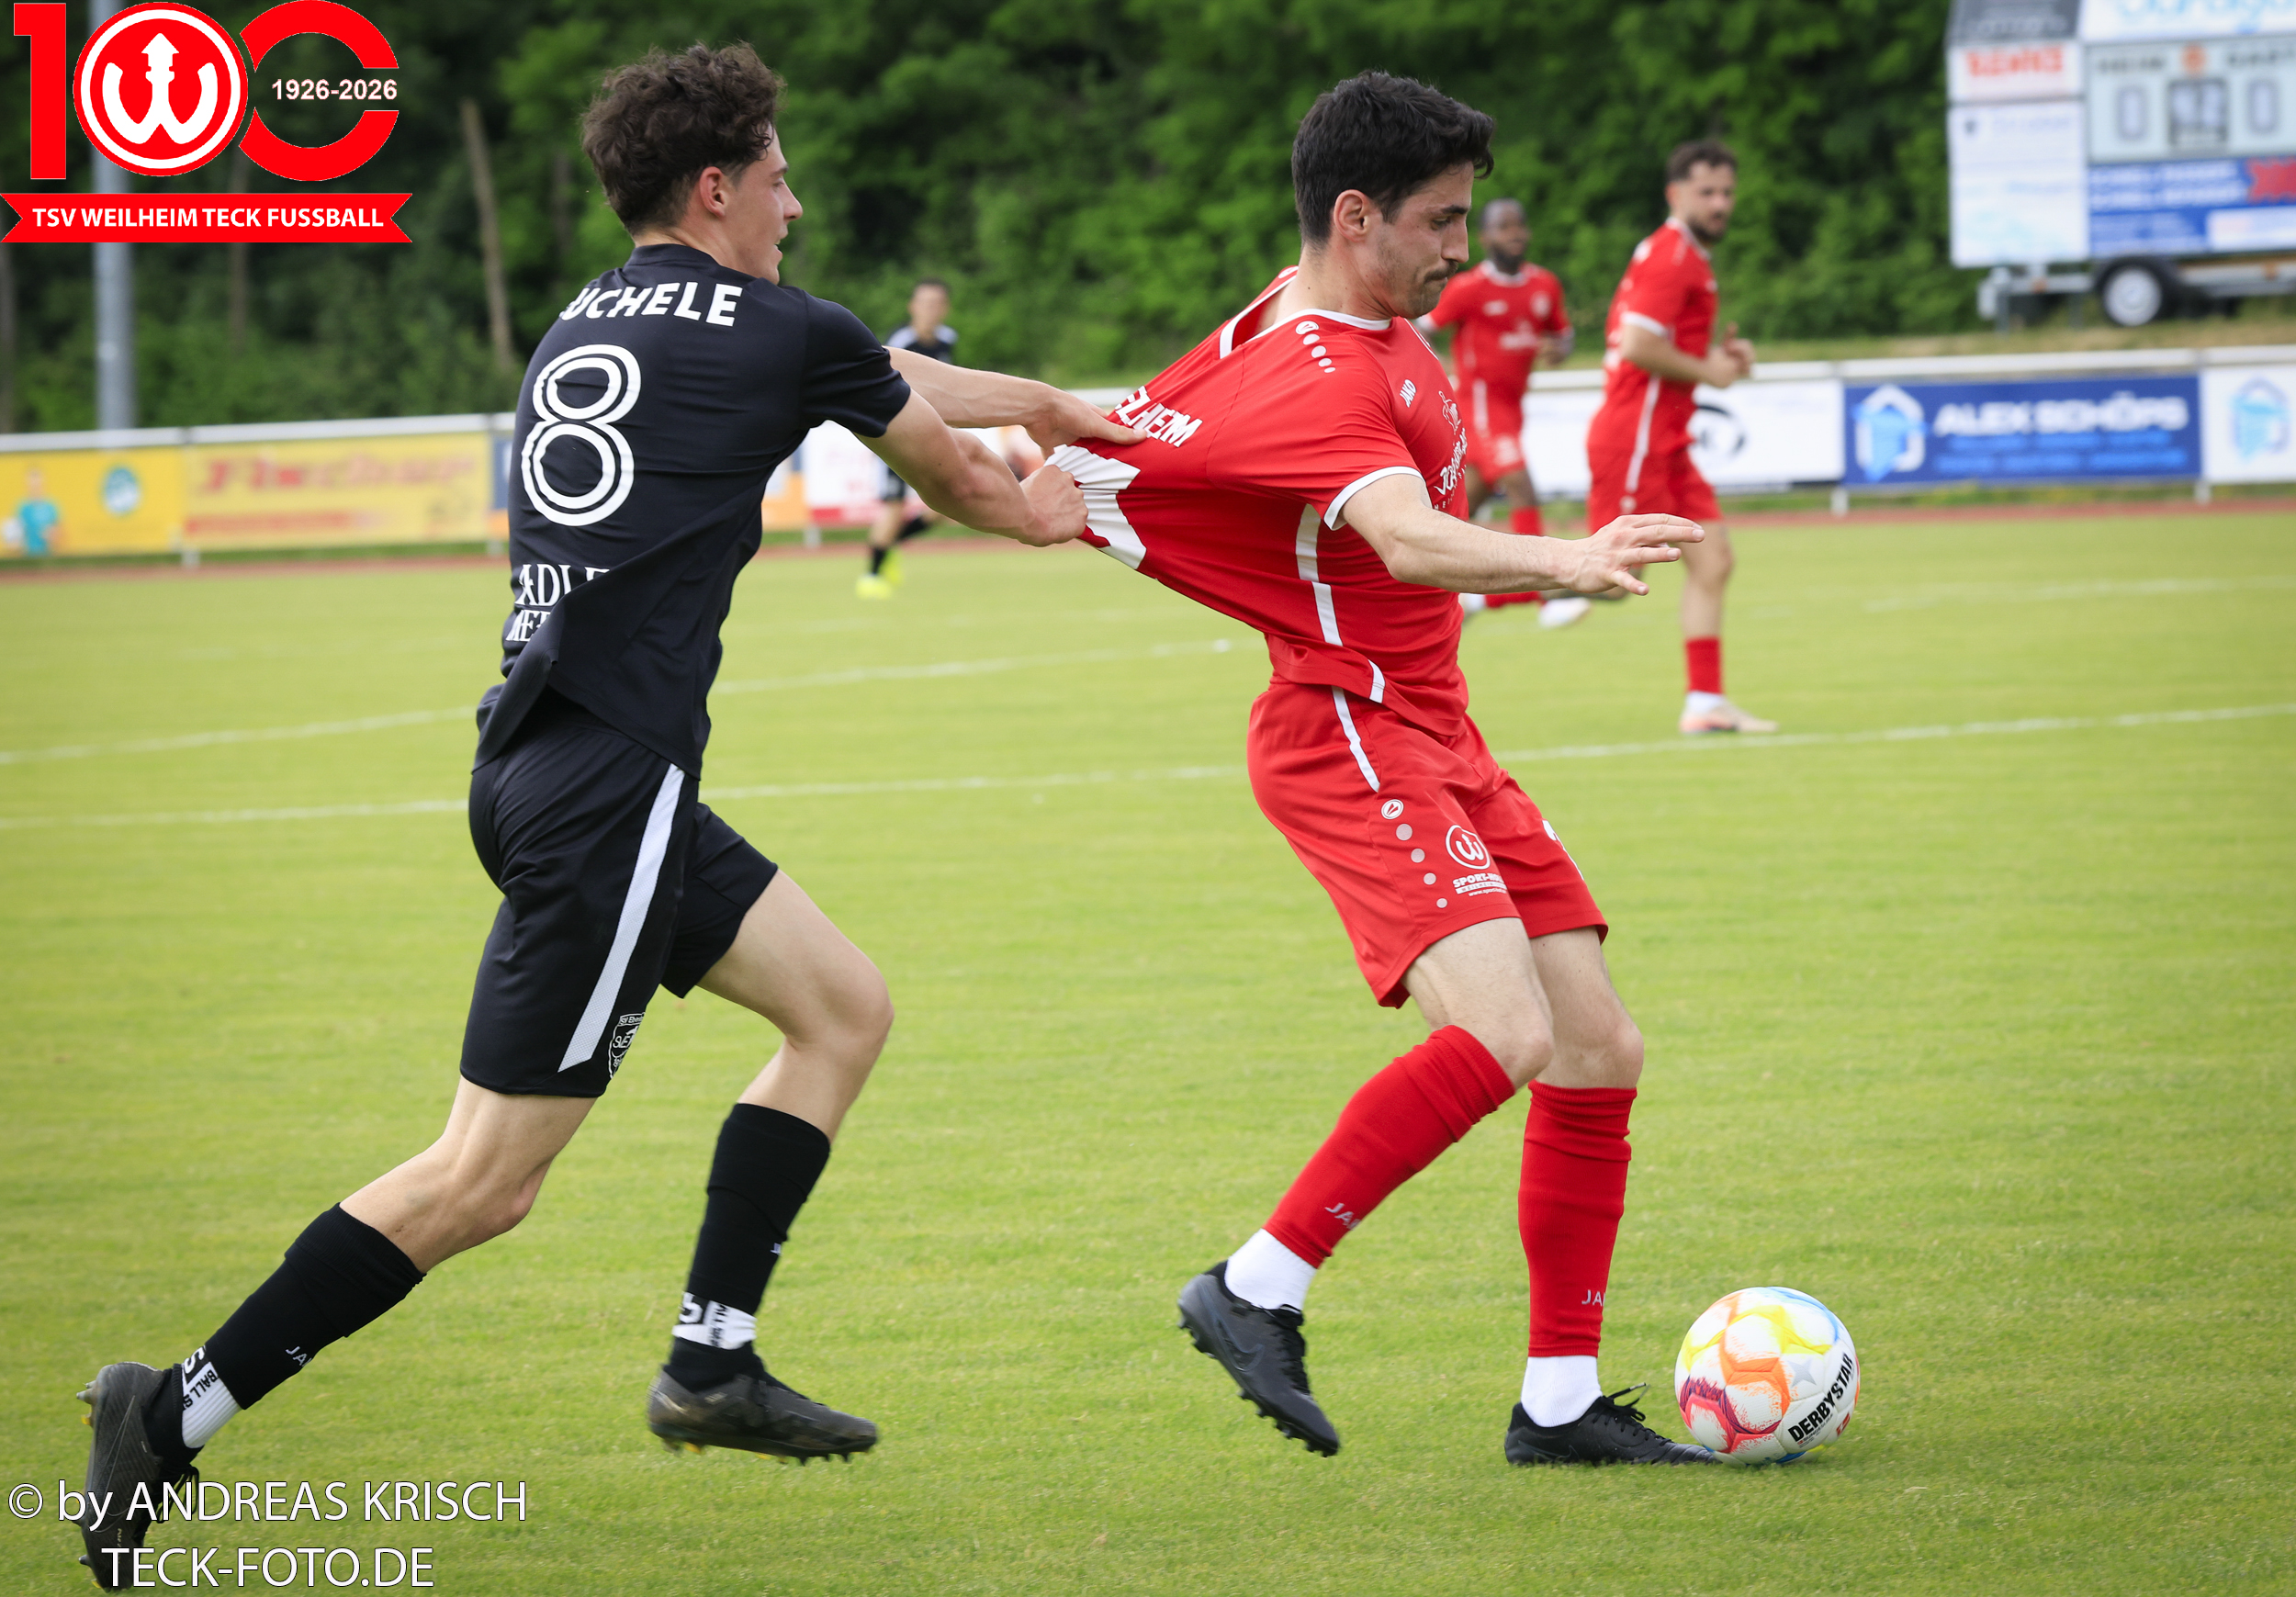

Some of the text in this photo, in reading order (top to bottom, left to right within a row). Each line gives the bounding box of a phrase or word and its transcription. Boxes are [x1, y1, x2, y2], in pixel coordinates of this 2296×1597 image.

[559, 281, 743, 327] UCHELE
[1400, 379, 1417, 409] JAKO
[521, 343, 641, 527] 8
[286, 1346, 312, 1367] JA
[189, 1369, 218, 1398] BALL
[1787, 1351, 1853, 1442] DERBYSTAR
